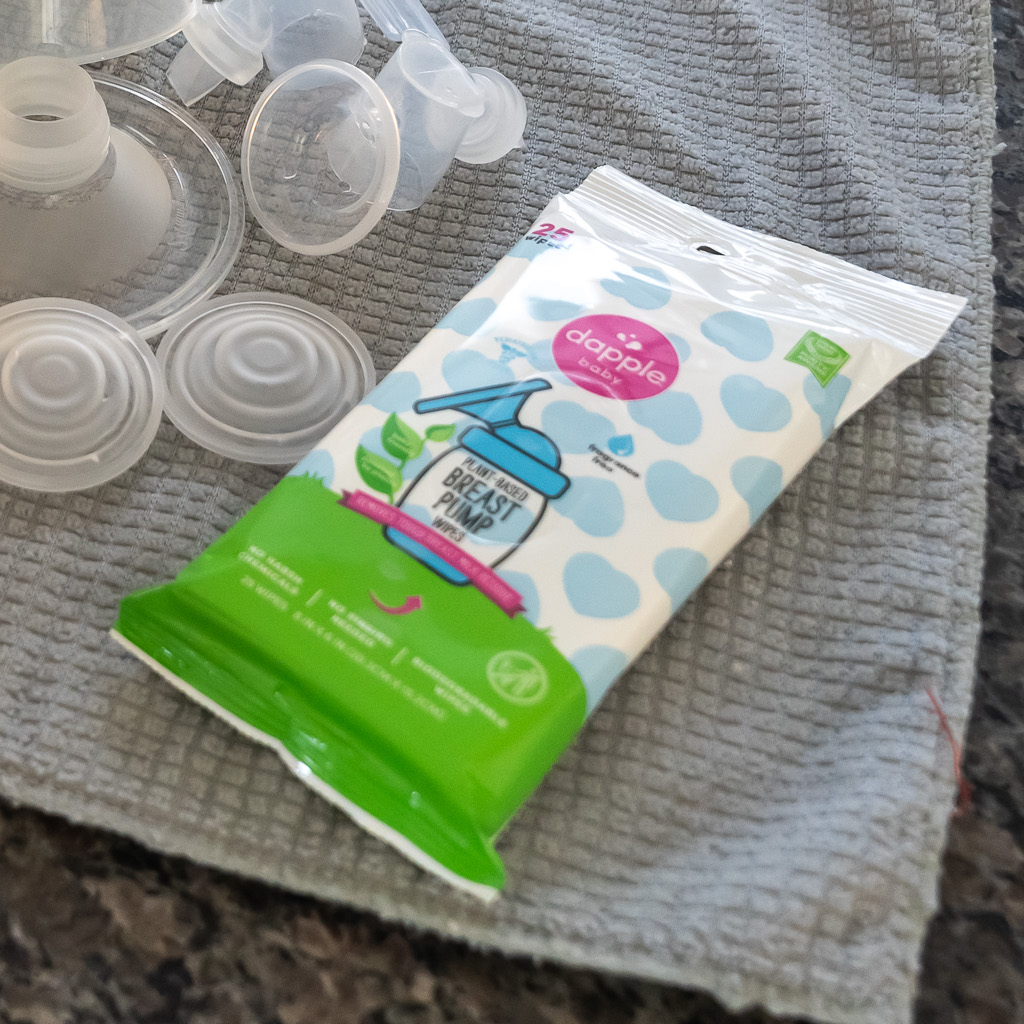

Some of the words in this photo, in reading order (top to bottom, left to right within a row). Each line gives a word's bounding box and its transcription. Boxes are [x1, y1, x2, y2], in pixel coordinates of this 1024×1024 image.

[530, 223, 574, 239] 25
[565, 326, 667, 386] dapple
[577, 356, 623, 386] baby
[442, 466, 522, 522] BREAST
[461, 456, 528, 502] PLANT-BASED
[432, 491, 494, 535] PUMP
[432, 515, 467, 542] WIPES
